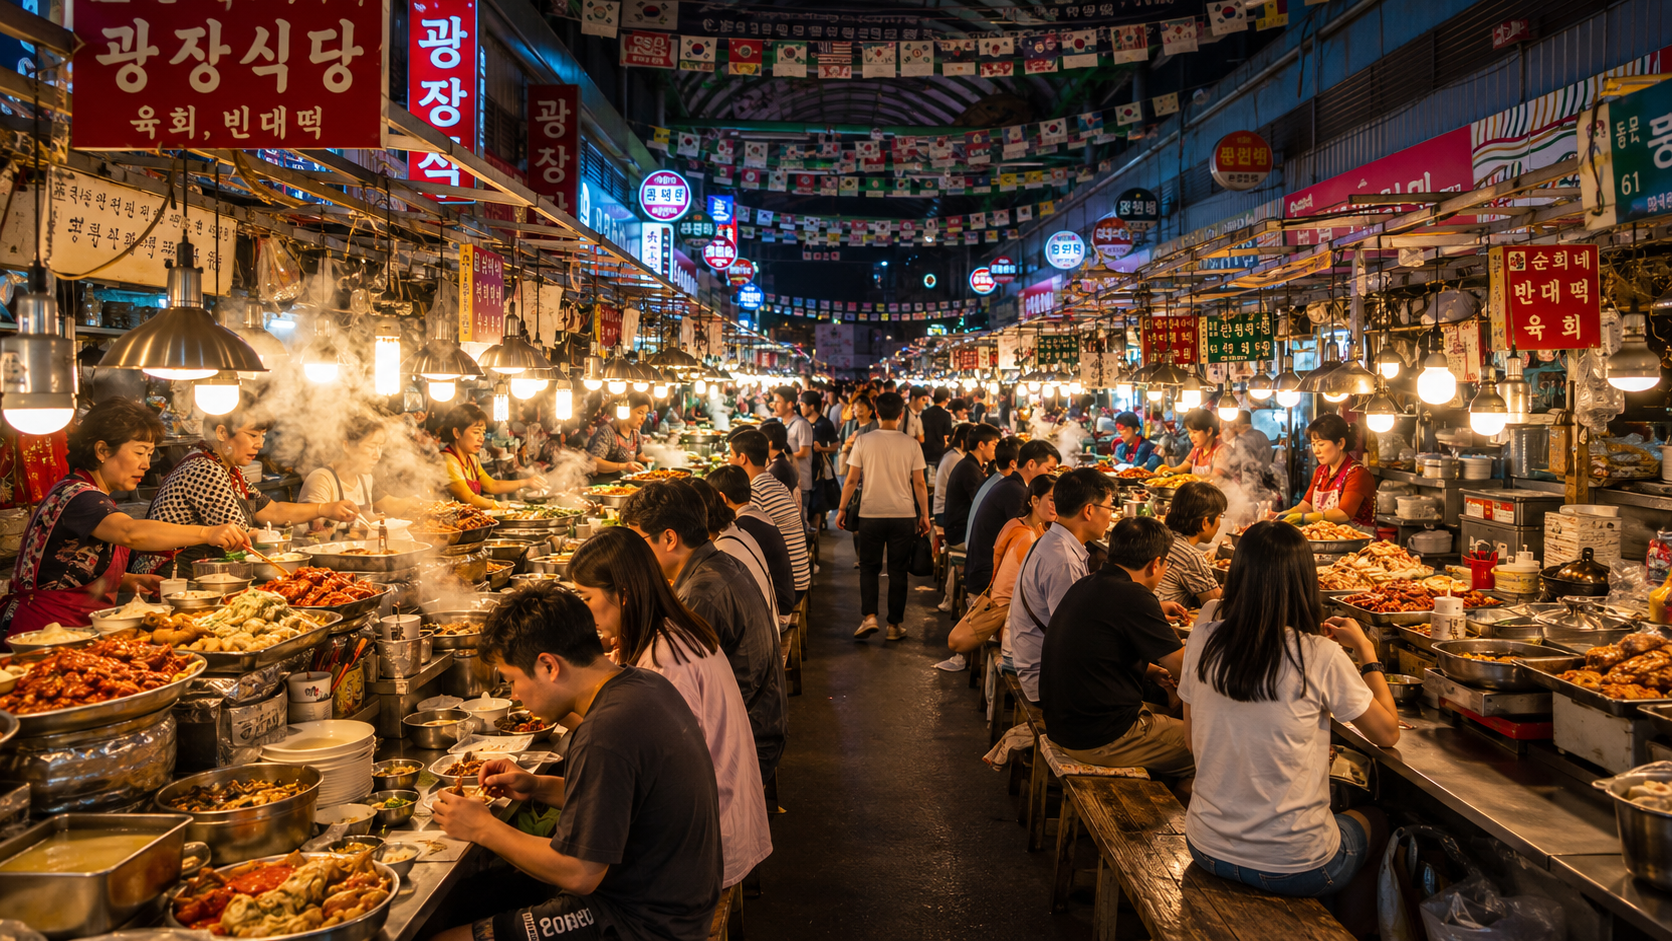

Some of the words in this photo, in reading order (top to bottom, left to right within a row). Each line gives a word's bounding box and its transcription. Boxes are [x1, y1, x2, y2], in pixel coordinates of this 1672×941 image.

[95, 18, 365, 94] 광장식당
[130, 105, 211, 140] 육회,
[223, 105, 323, 140] 빈대떡
[1621, 171, 1640, 196] 61
[1531, 250, 1590, 271] 순희네
[1523, 314, 1582, 341] 육회
